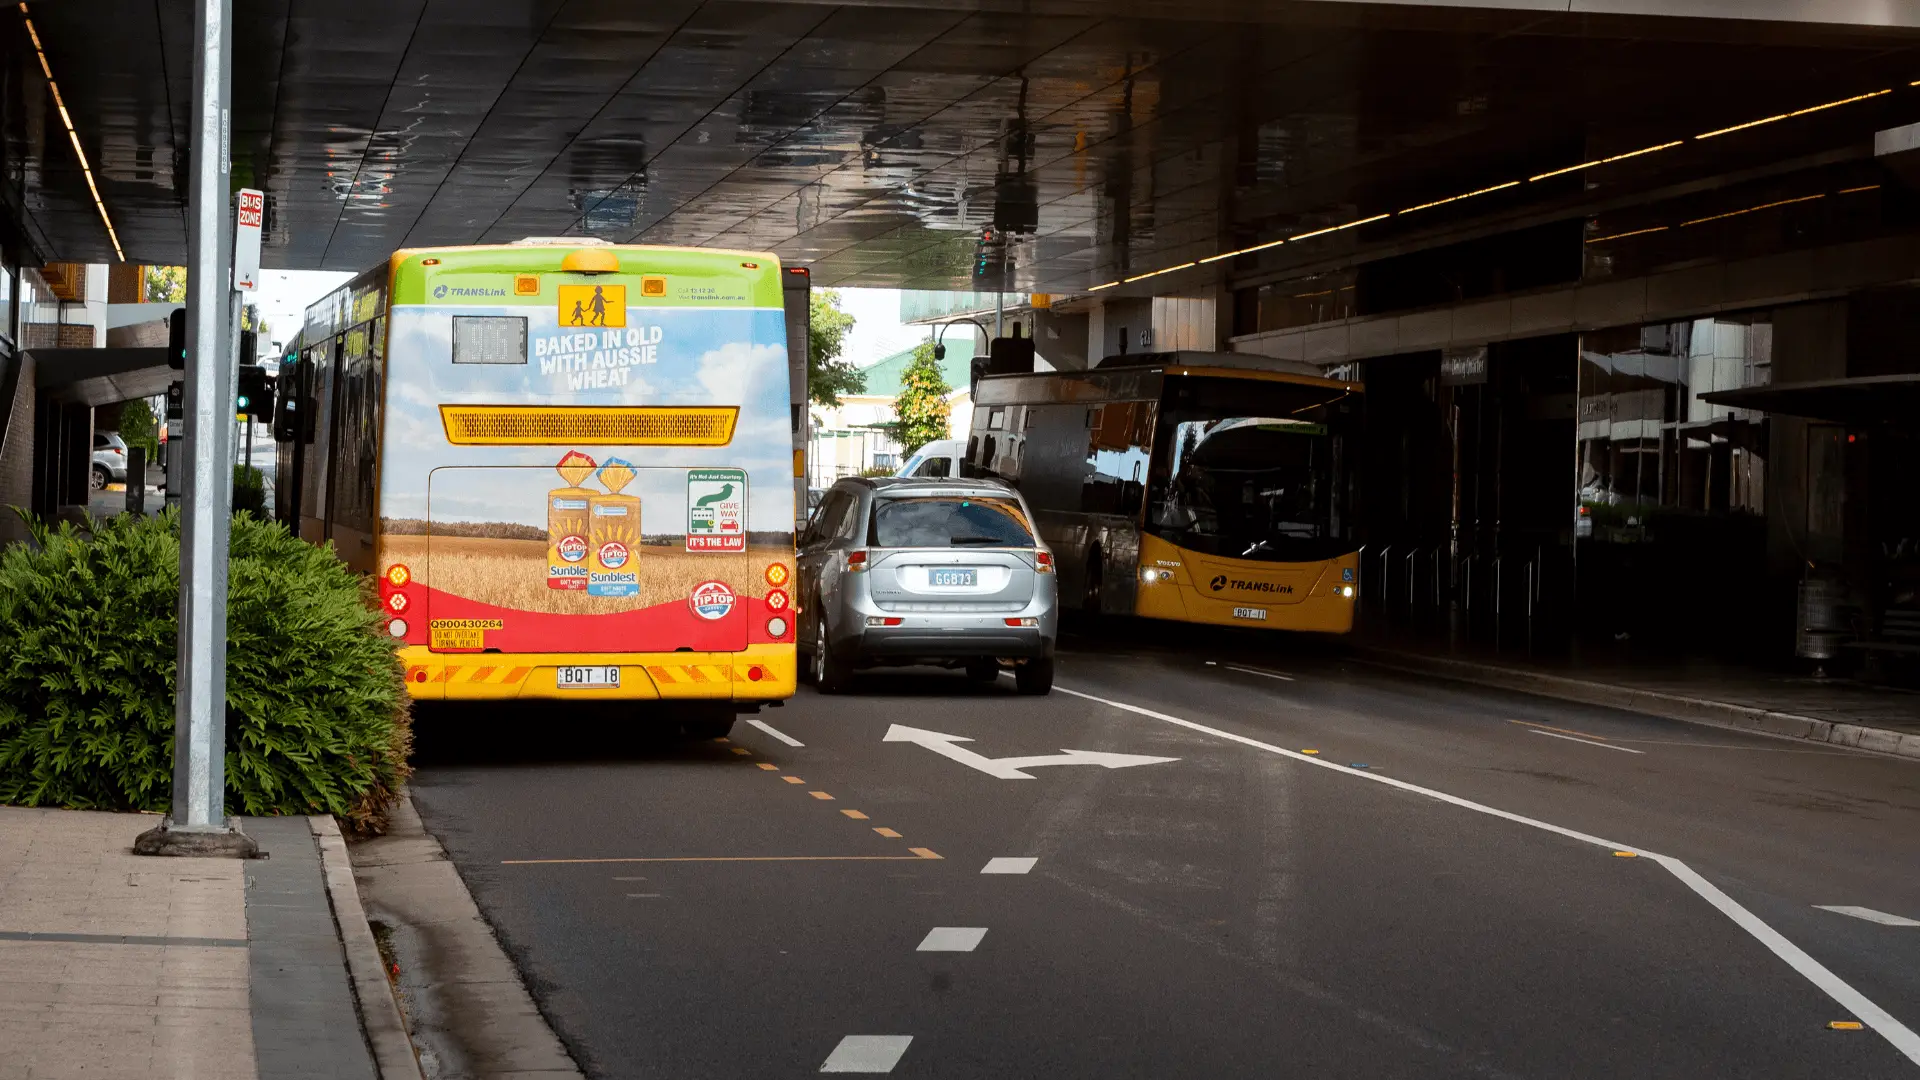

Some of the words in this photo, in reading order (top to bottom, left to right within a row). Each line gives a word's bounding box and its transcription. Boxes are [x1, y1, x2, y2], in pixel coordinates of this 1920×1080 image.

[241, 195, 262, 210] BUS
[240, 210, 260, 225] ZONE
[451, 288, 506, 296] TRANSLink
[535, 333, 598, 356] BAKED
[602, 329, 622, 349] IN
[626, 326, 663, 346] QLD
[540, 352, 588, 375] WITH
[591, 345, 658, 370] AUSSIE
[567, 367, 631, 391] WHEAT
[689, 537, 705, 547] IT'S
[706, 537, 720, 546] THE
[724, 537, 742, 547] LAW
[1156, 559, 1181, 567] VOLVO
[590, 572, 636, 582] Sunblest
[1230, 580, 1293, 594] TRANSLink
[430, 620, 503, 628] Q900430264
[436, 639, 456, 647] TURNING
[460, 639, 480, 647] VEHICLE
[565, 668, 593, 683] BQT
[604, 668, 618, 683] 18
